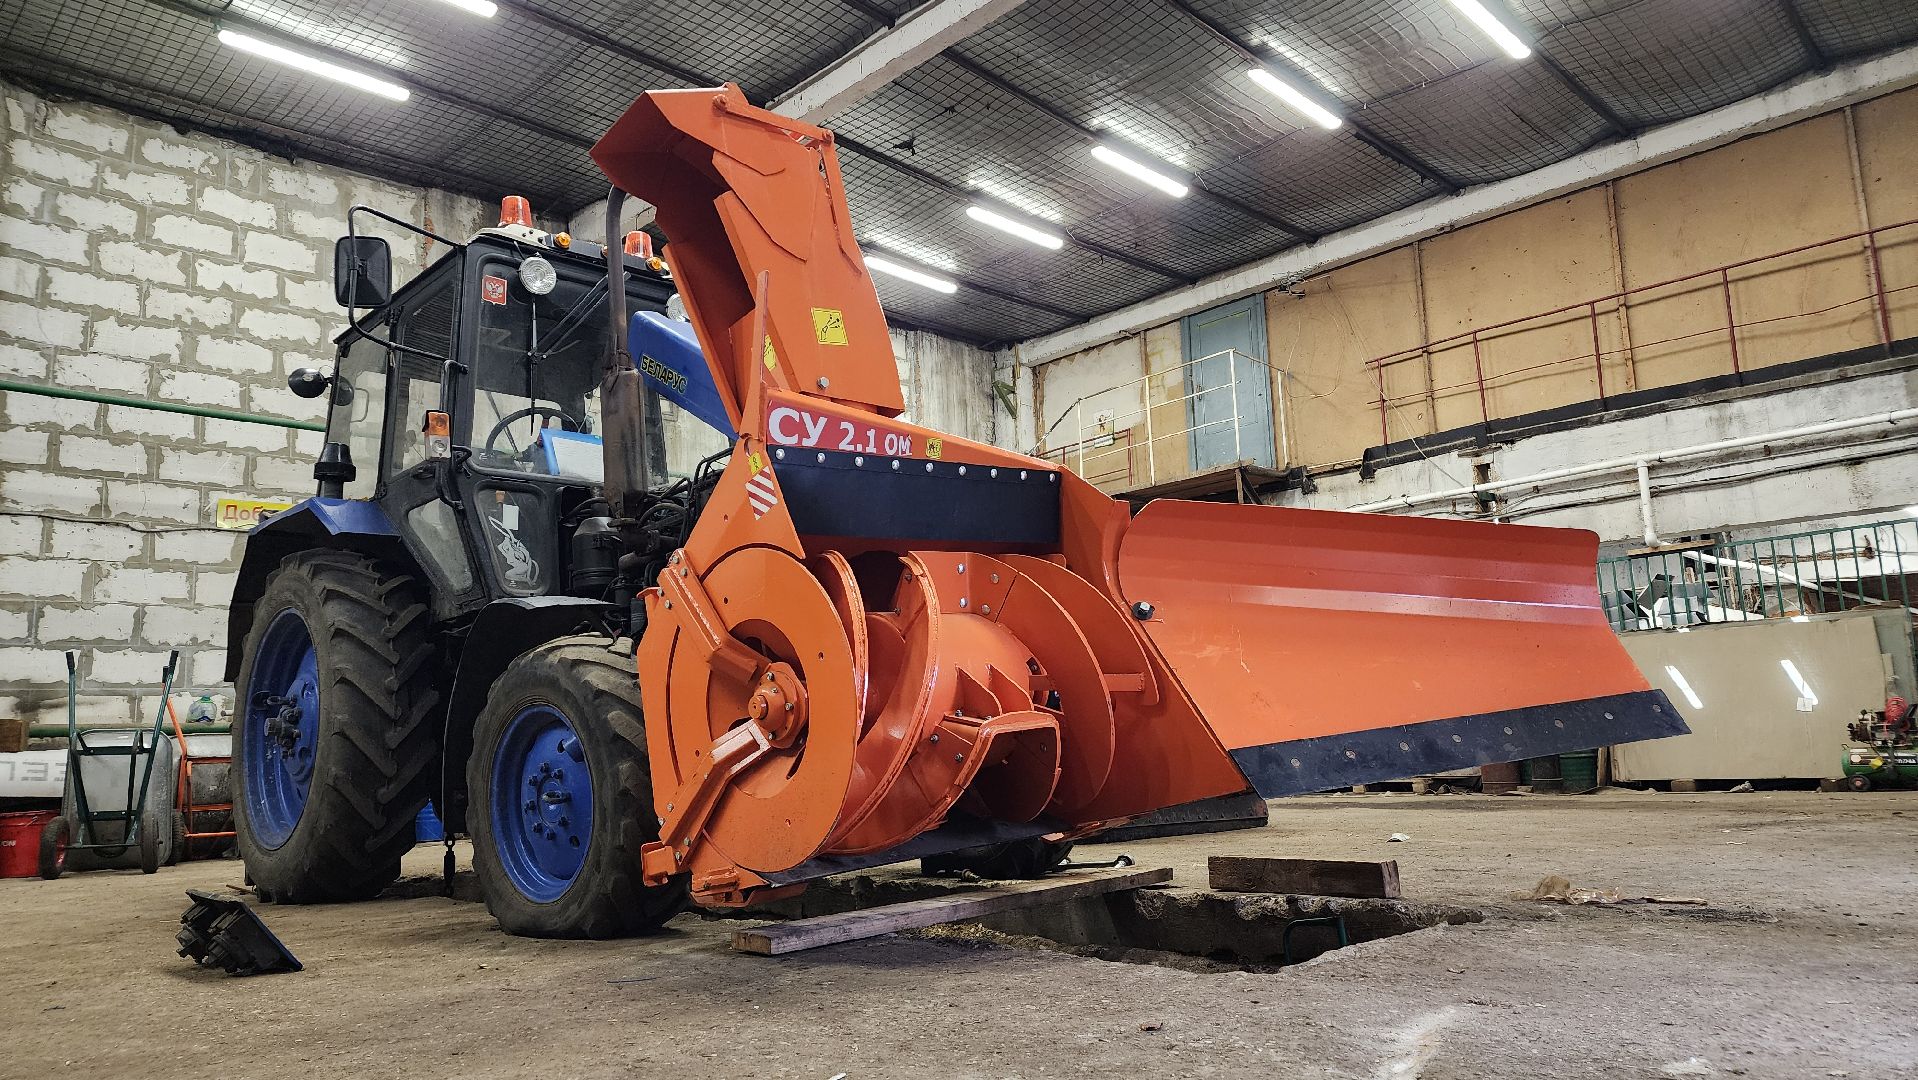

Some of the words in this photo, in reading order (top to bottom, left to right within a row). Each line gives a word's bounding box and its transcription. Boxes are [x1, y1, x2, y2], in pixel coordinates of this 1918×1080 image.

[641, 354, 688, 395] БЕЛАРУС
[768, 407, 828, 446] СУ
[838, 421, 877, 454] 2.1
